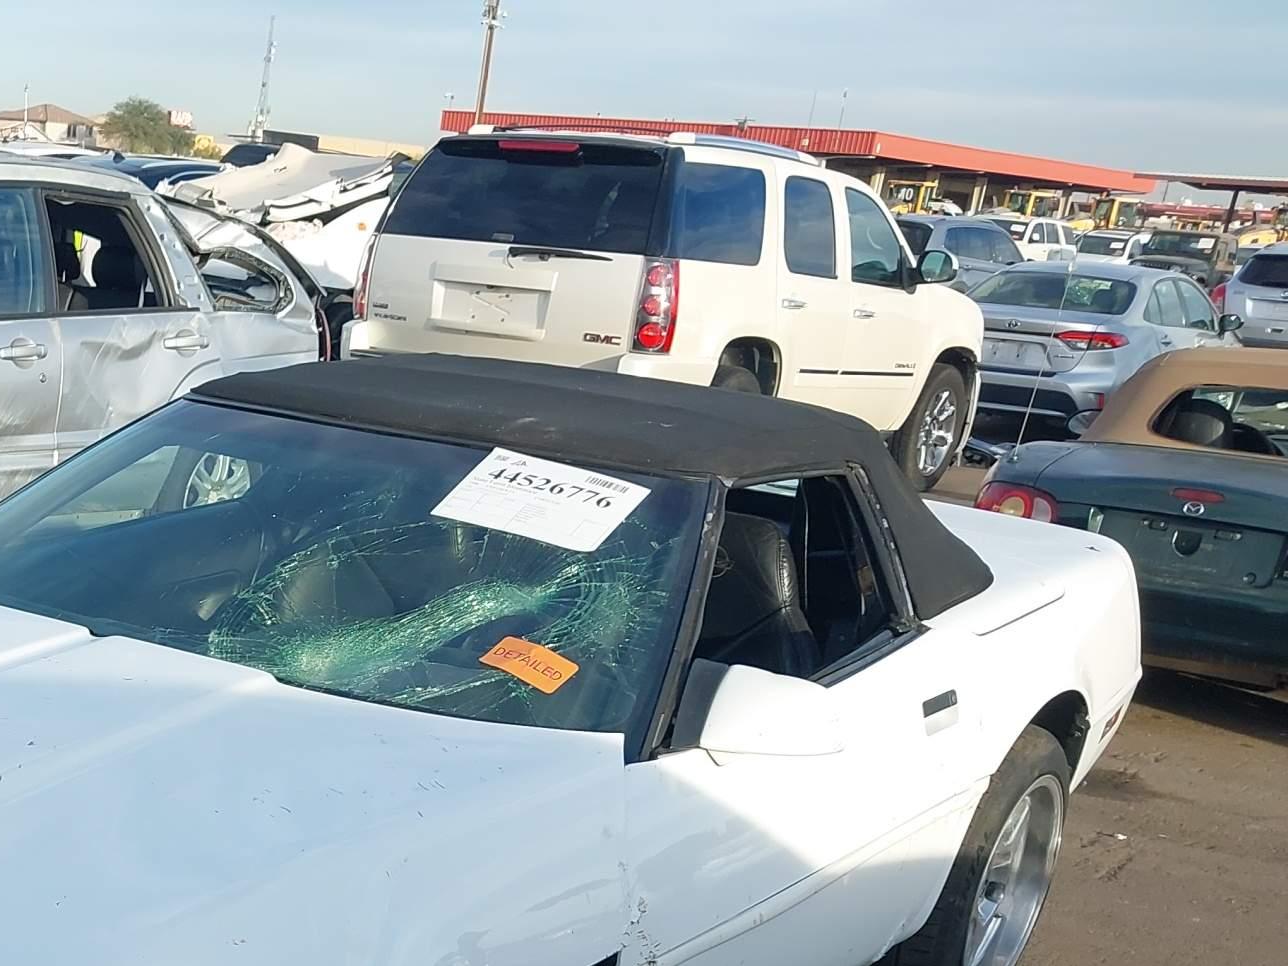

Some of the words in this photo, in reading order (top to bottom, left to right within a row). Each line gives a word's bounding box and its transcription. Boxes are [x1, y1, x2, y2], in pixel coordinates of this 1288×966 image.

[583, 332, 622, 346] GMC
[488, 467, 616, 509] 44526776
[493, 646, 563, 681] DETAILED
